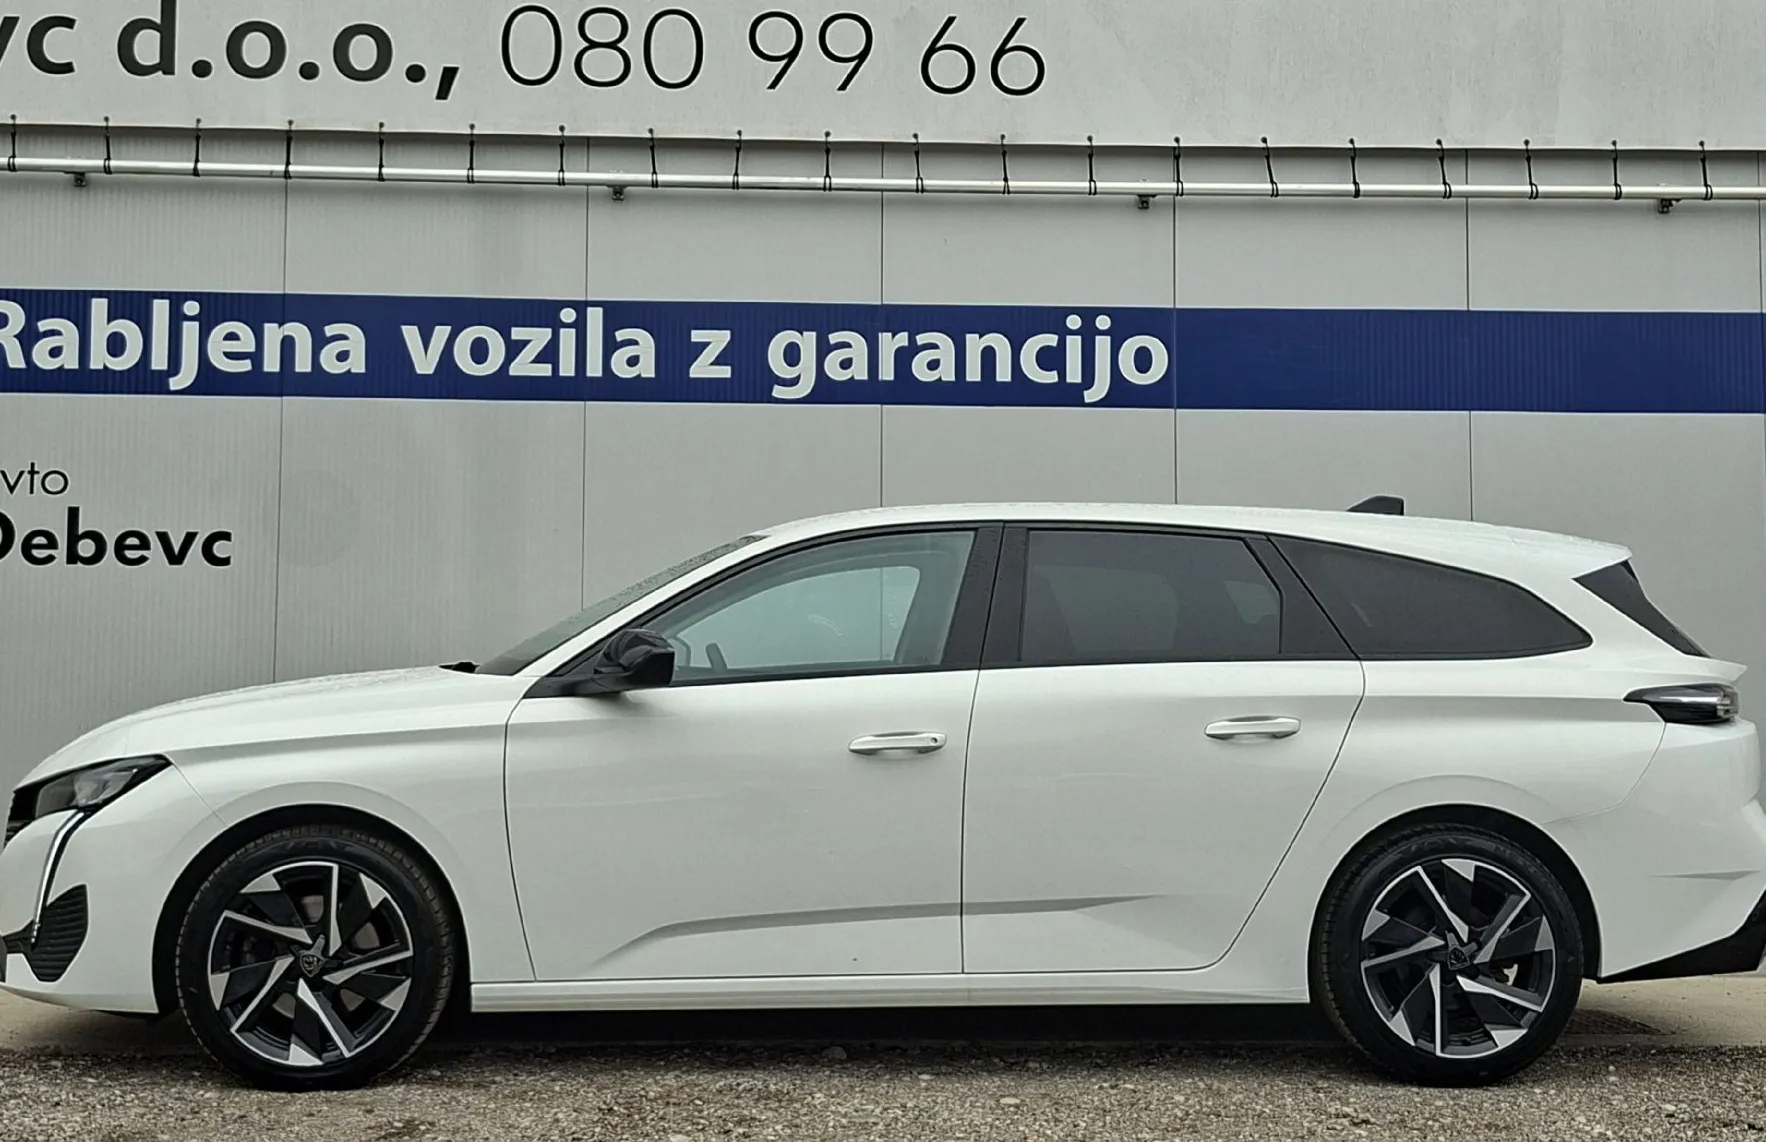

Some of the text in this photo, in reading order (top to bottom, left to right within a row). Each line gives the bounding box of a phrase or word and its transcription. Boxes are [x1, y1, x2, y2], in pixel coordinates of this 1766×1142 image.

[117, 0, 460, 101] d.o.o.,
[501, 5, 704, 90] 080
[748, 11, 873, 92] 99
[920, 15, 1045, 96] 66
[0, 297, 1169, 403] Rabljena vozila z garancijo
[0, 461, 69, 496] vto
